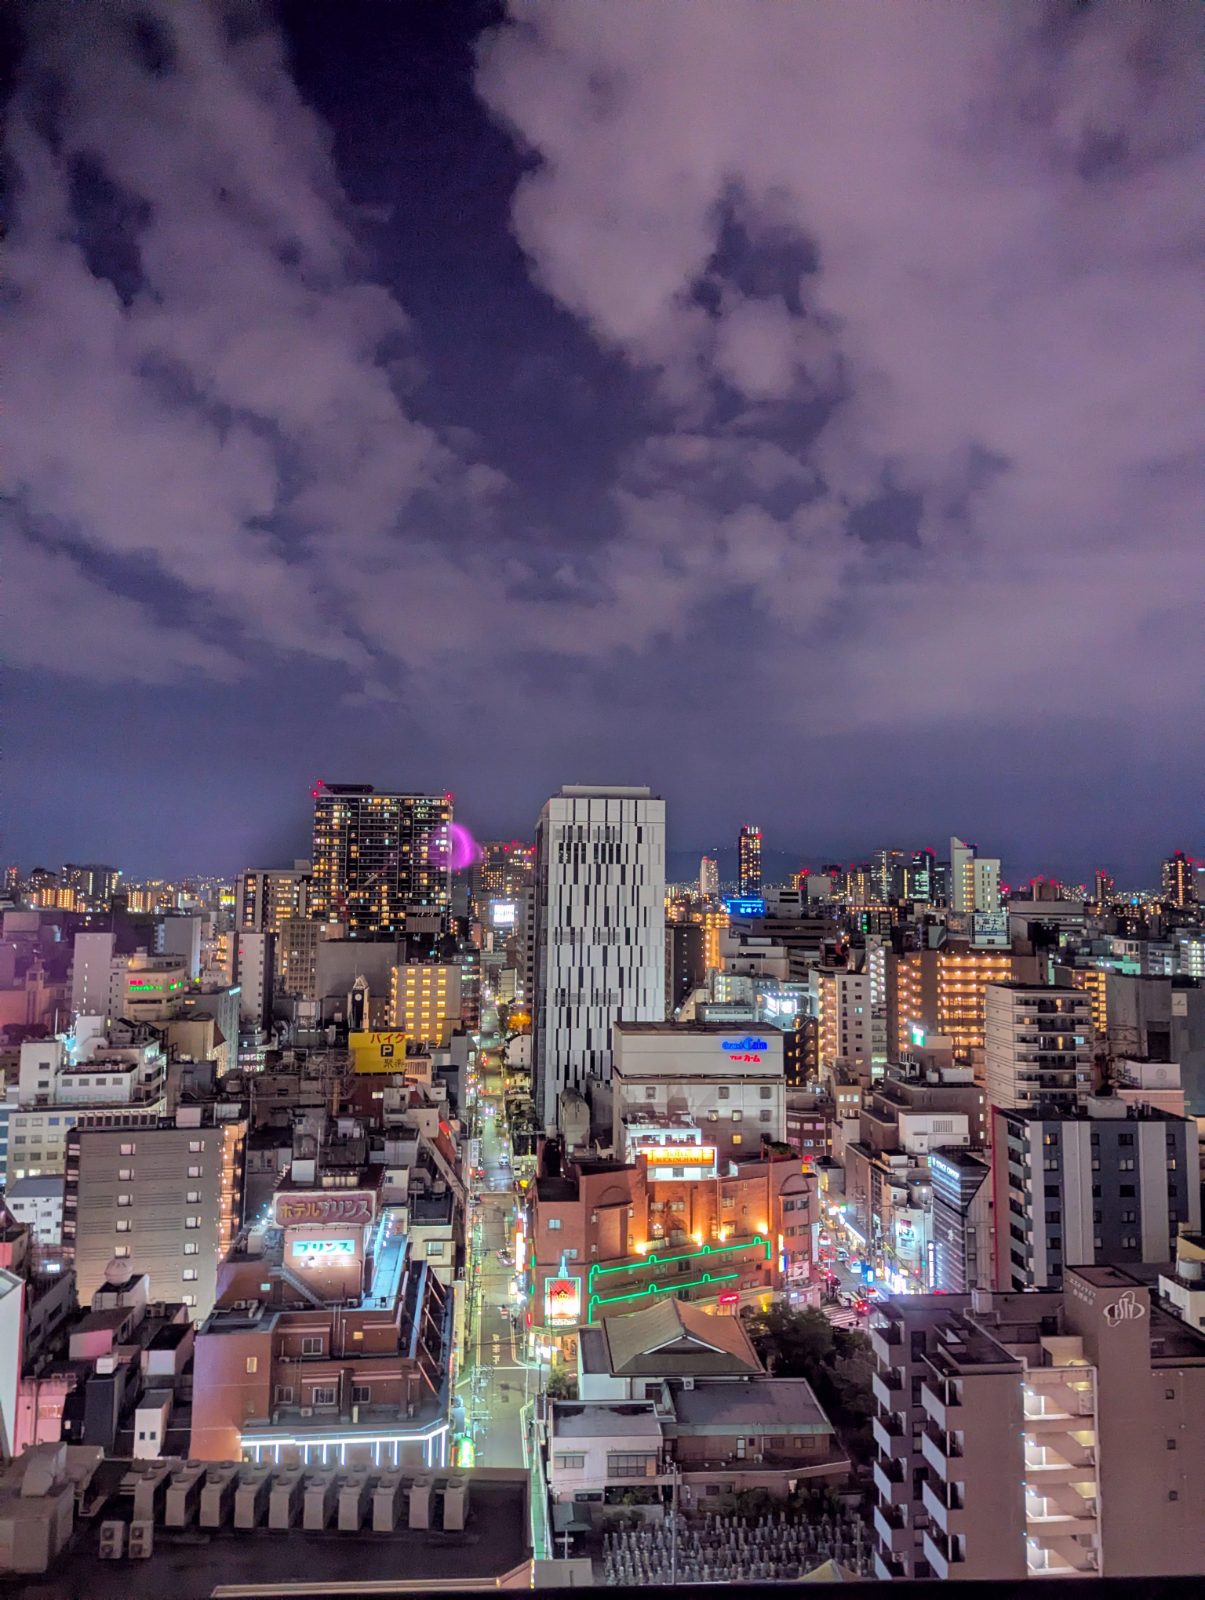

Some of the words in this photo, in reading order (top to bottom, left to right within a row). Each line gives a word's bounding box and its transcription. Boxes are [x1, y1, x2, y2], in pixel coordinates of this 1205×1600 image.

[370, 1033, 405, 1044] バイク
[382, 1045, 392, 1056] P
